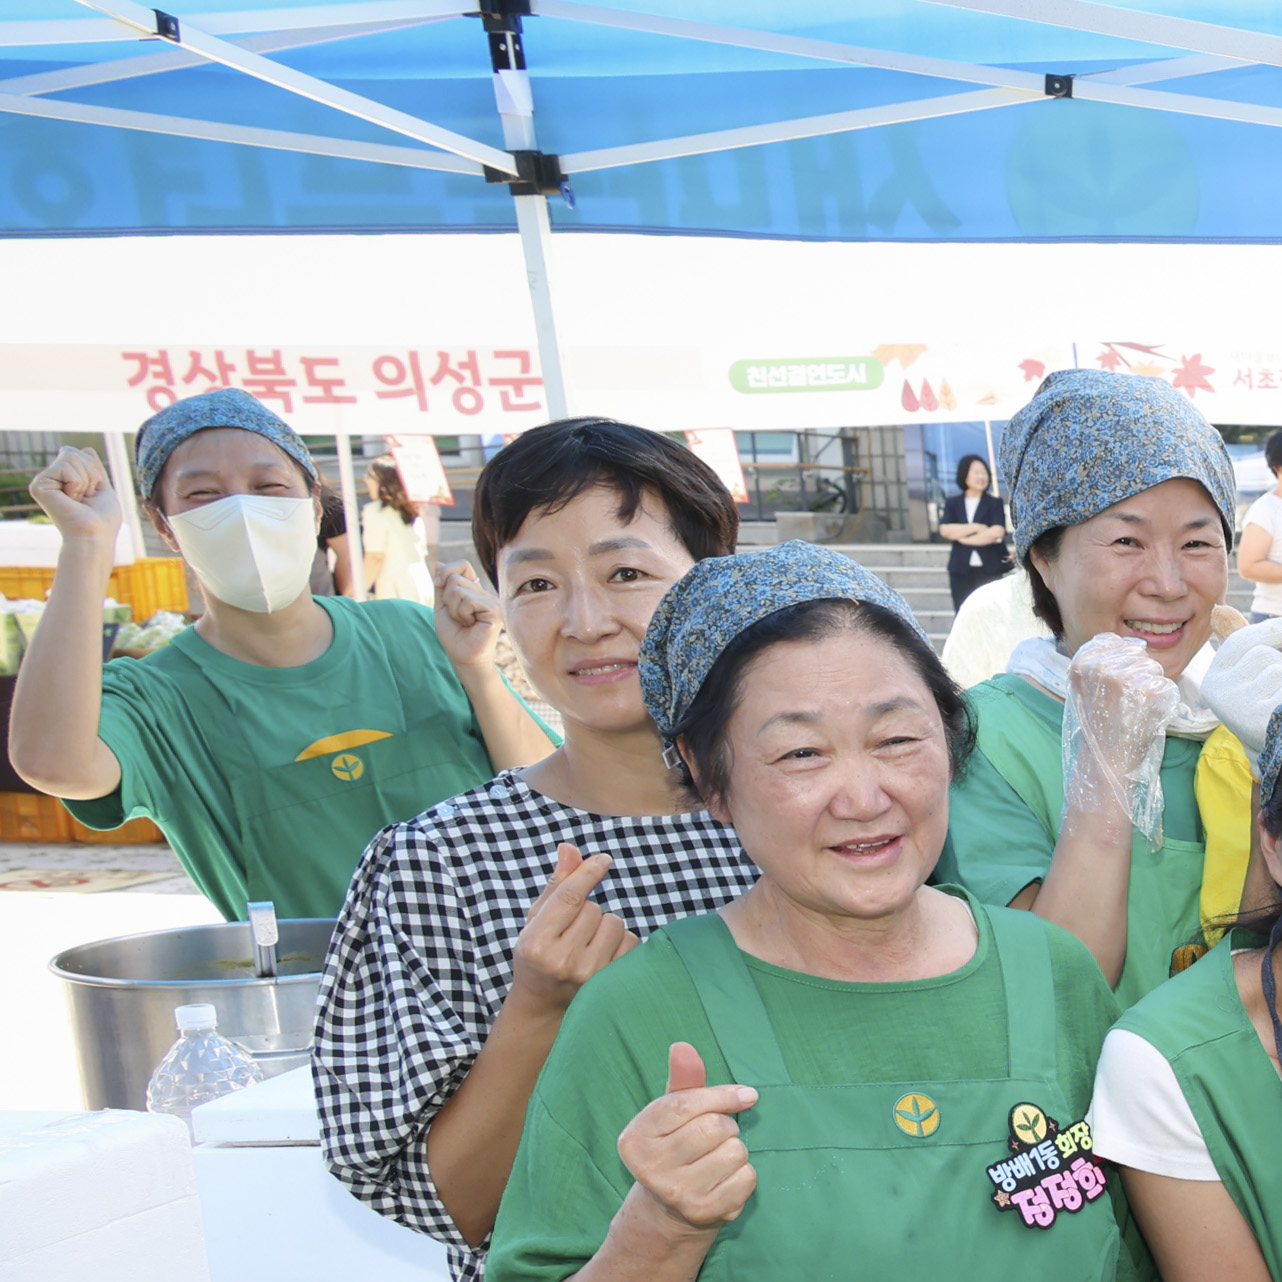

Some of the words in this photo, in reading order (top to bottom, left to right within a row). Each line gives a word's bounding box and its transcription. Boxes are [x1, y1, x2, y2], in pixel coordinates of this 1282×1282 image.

[121, 350, 357, 413] 경상북도
[372, 349, 545, 415] 의성군
[988, 1138, 1061, 1192] 방배1동
[1054, 1121, 1094, 1159] 회장
